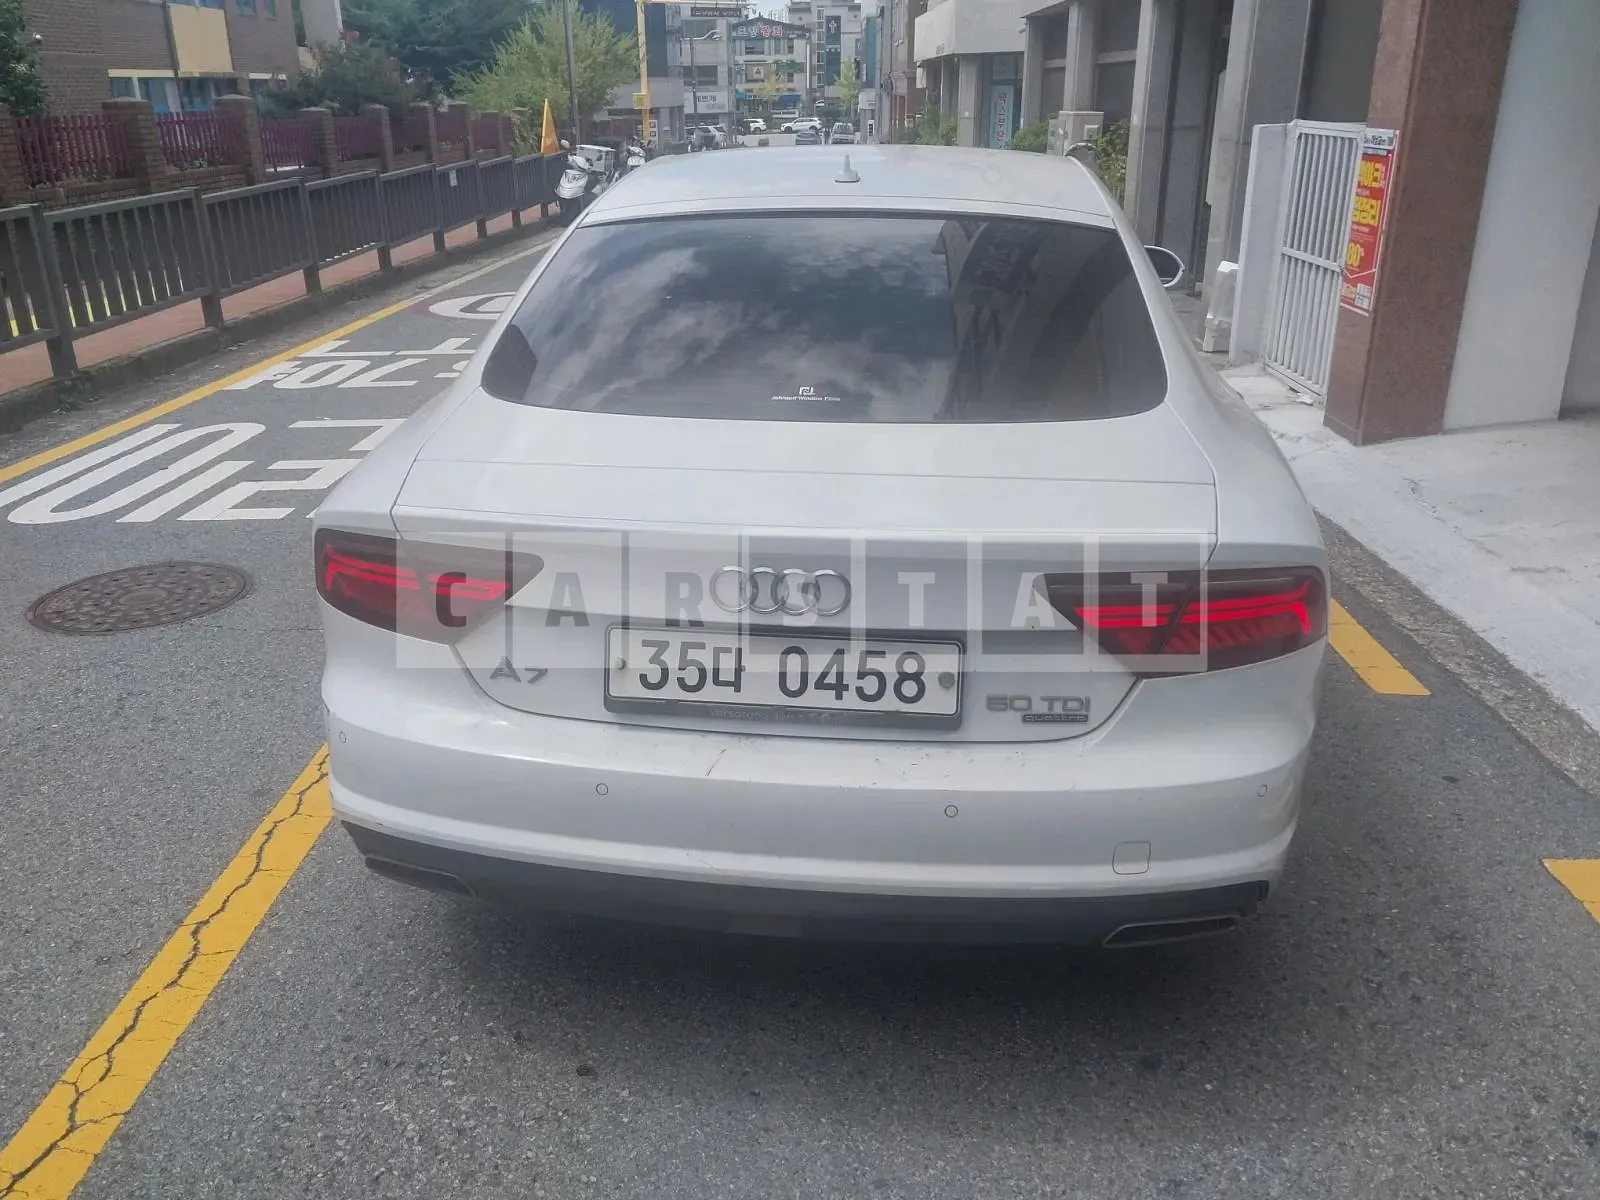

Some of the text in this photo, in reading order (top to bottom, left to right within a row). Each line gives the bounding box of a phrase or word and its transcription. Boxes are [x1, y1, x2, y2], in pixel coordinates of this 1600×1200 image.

[223, 337, 480, 391] 구역
[0, 418, 408, 524] 린이
[489, 656, 548, 683] A7
[778, 645, 926, 704] 0458
[1022, 713, 1088, 723] quattro
[1040, 696, 1091, 713] TDI
